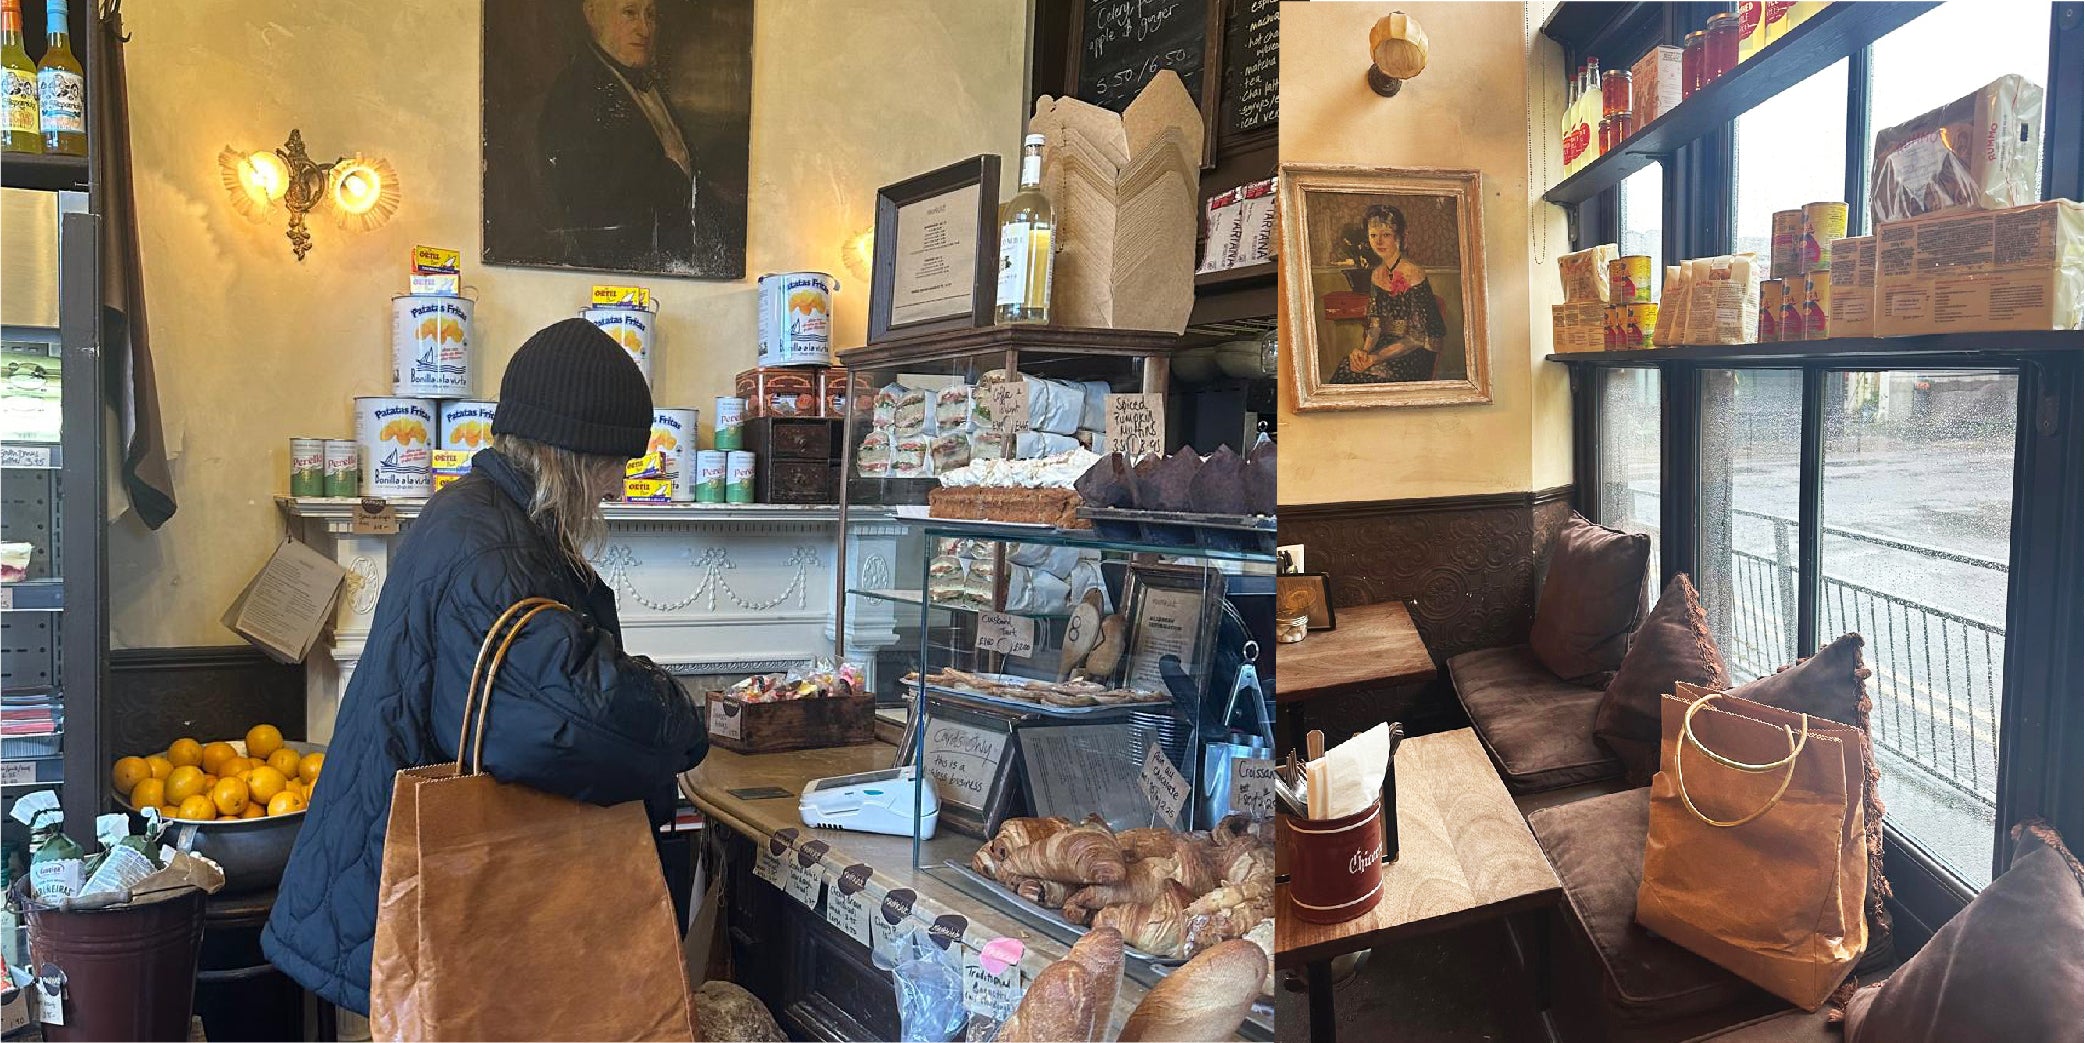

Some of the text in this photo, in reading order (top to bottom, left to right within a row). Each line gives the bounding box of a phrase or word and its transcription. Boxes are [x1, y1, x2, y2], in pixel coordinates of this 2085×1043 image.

[1988, 122, 1999, 162] RUMMO
[410, 304, 445, 319] Patatas
[625, 315, 646, 332] Fritas
[1115, 395, 1148, 413] Spiced
[374, 404, 431, 422] Patatas Fritas
[658, 414, 682, 430] Fritas
[374, 468, 400, 485] Bonilla
[934, 728, 964, 749] Cards
